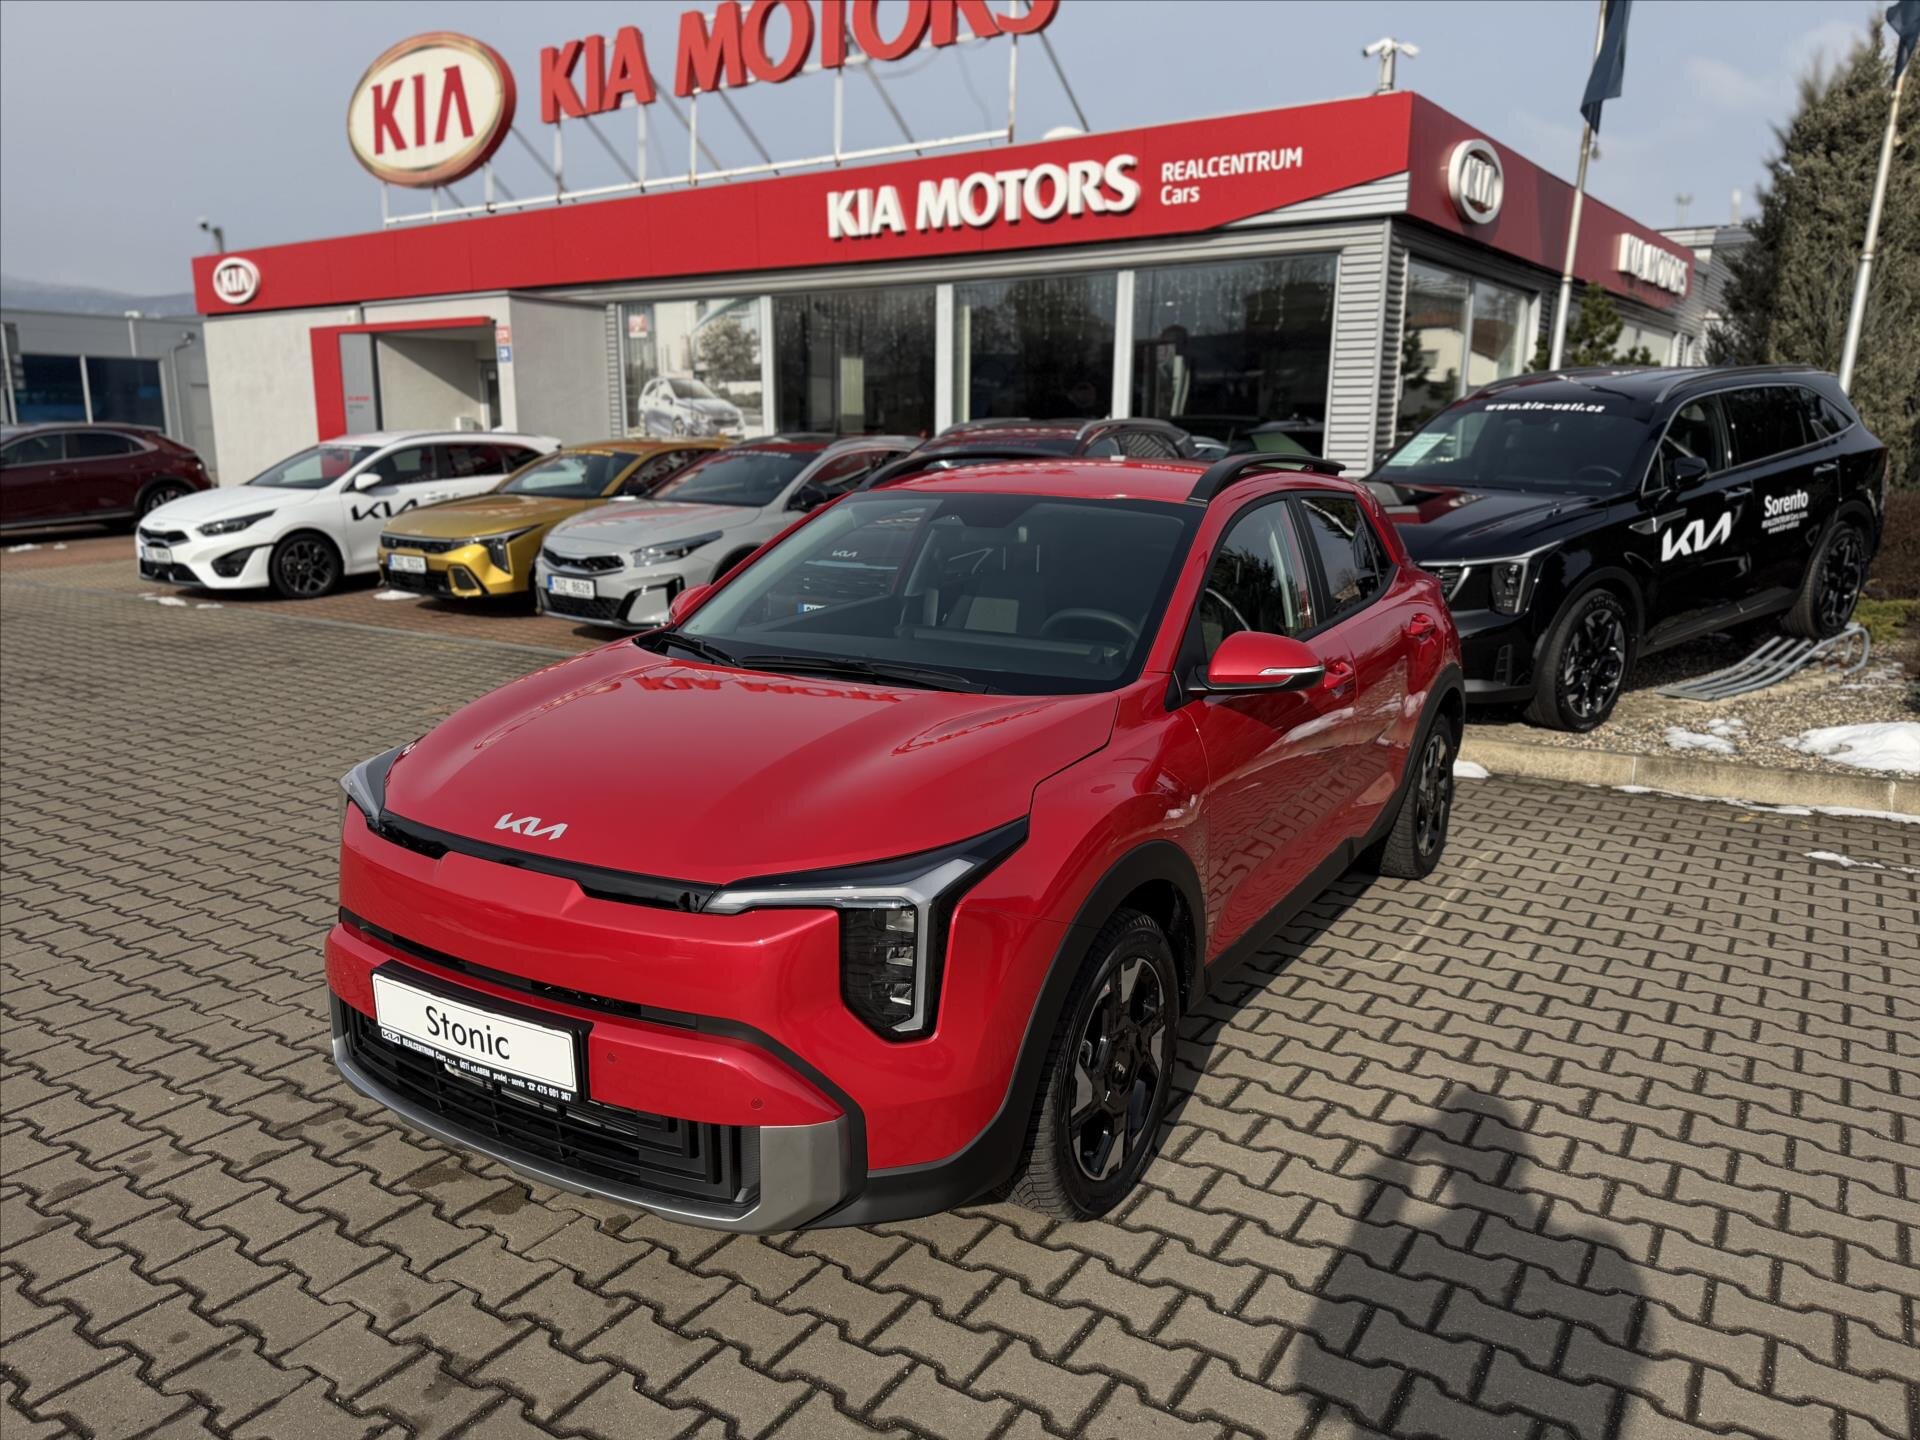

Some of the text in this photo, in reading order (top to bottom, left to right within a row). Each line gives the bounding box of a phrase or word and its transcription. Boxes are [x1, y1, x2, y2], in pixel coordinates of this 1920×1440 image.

[541, 26, 656, 123] KIA
[371, 65, 475, 156] KIA
[1161, 147, 1303, 182] REALCENTRUM
[827, 154, 1140, 238] KIA MOTORS
[1161, 185, 1200, 206] Cars
[220, 268, 251, 292] KIA
[1764, 489, 1809, 518] Sorento
[1661, 511, 1732, 562] KIA
[494, 812, 568, 841] KIA
[383, 1030, 400, 1043] KIA
[425, 1005, 510, 1060] Stonic
[537, 1084, 548, 1096] 475
